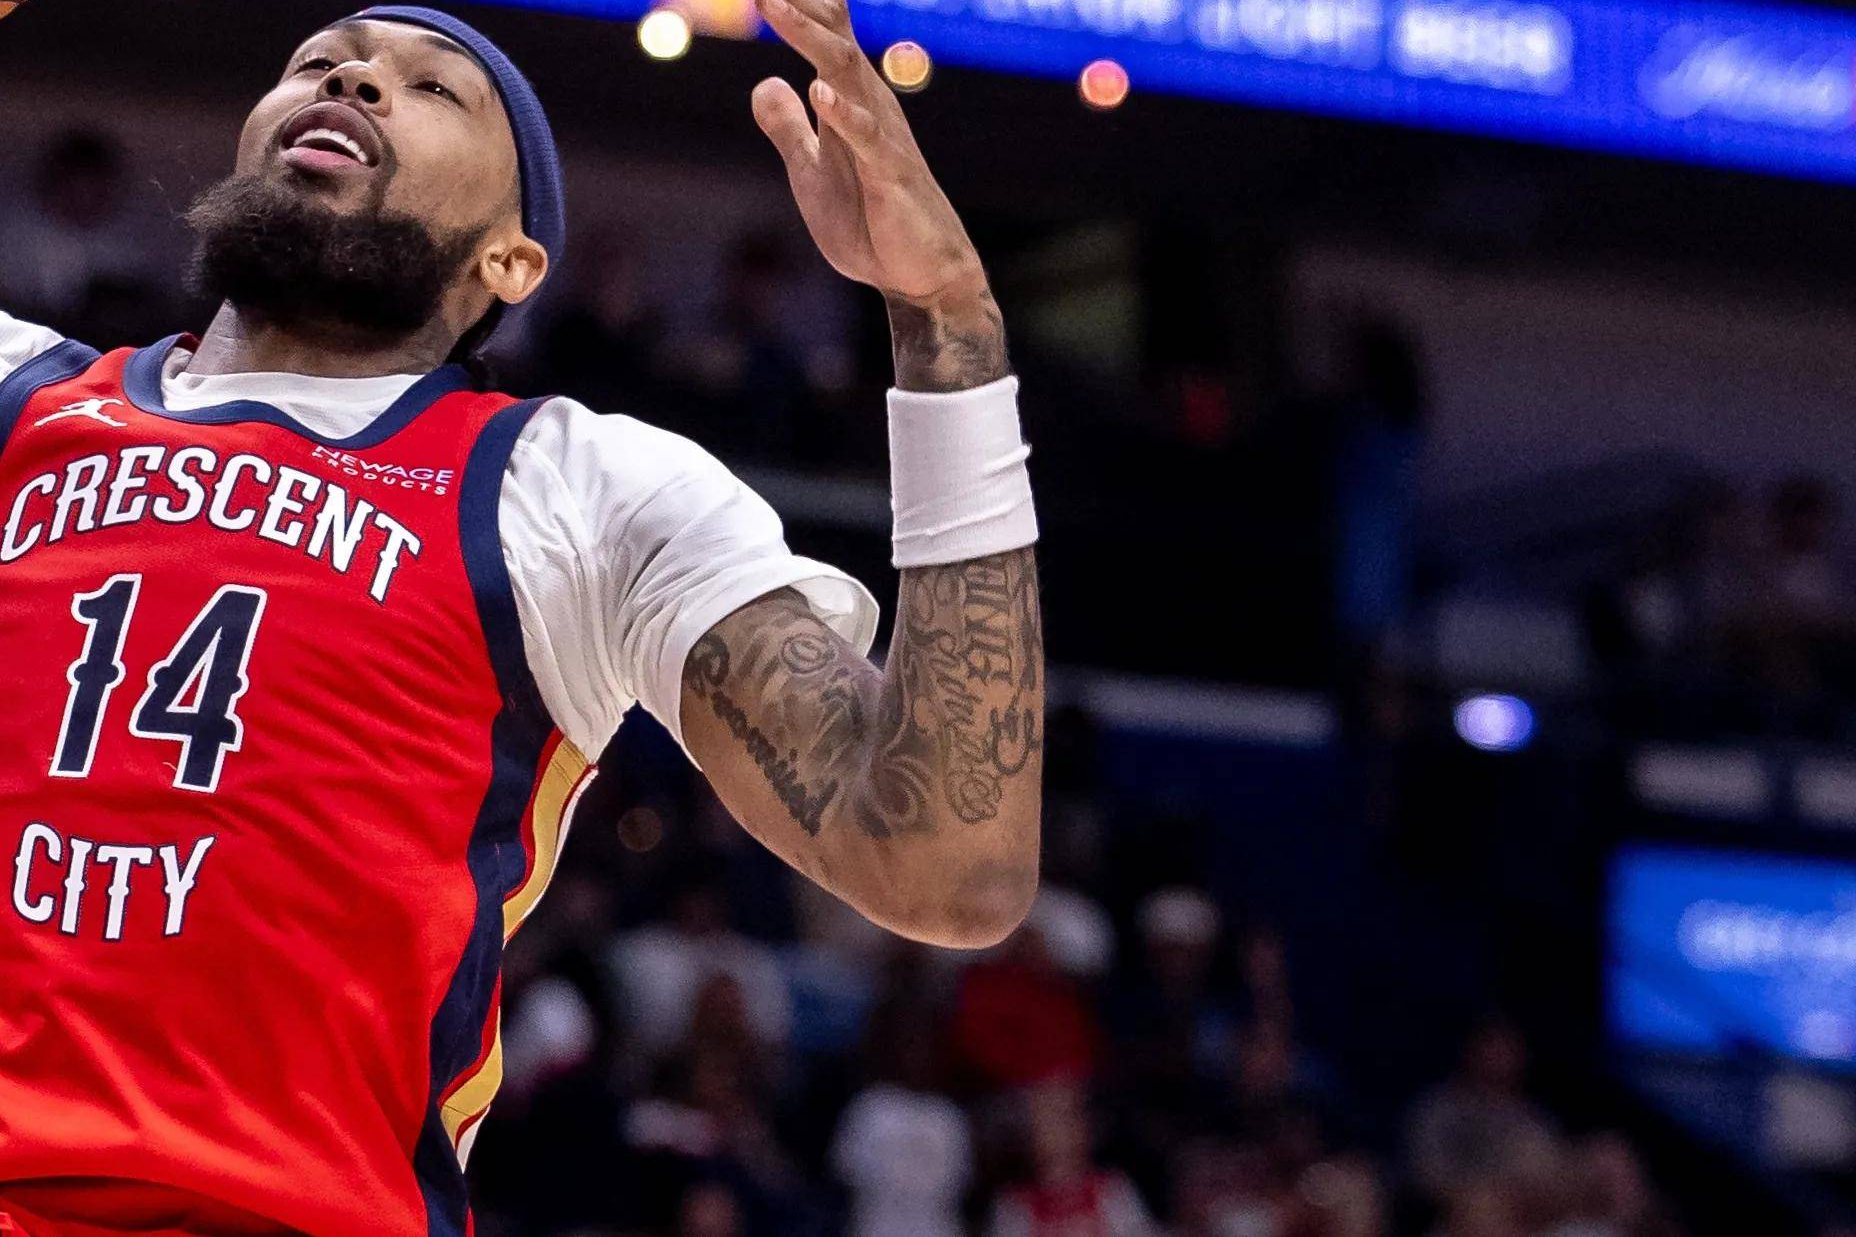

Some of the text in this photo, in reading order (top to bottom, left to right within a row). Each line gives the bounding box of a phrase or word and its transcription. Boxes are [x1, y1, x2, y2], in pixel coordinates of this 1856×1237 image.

[314, 445, 455, 485] NEWAGE
[48, 573, 268, 794] 14
[12, 822, 215, 942] CITY
